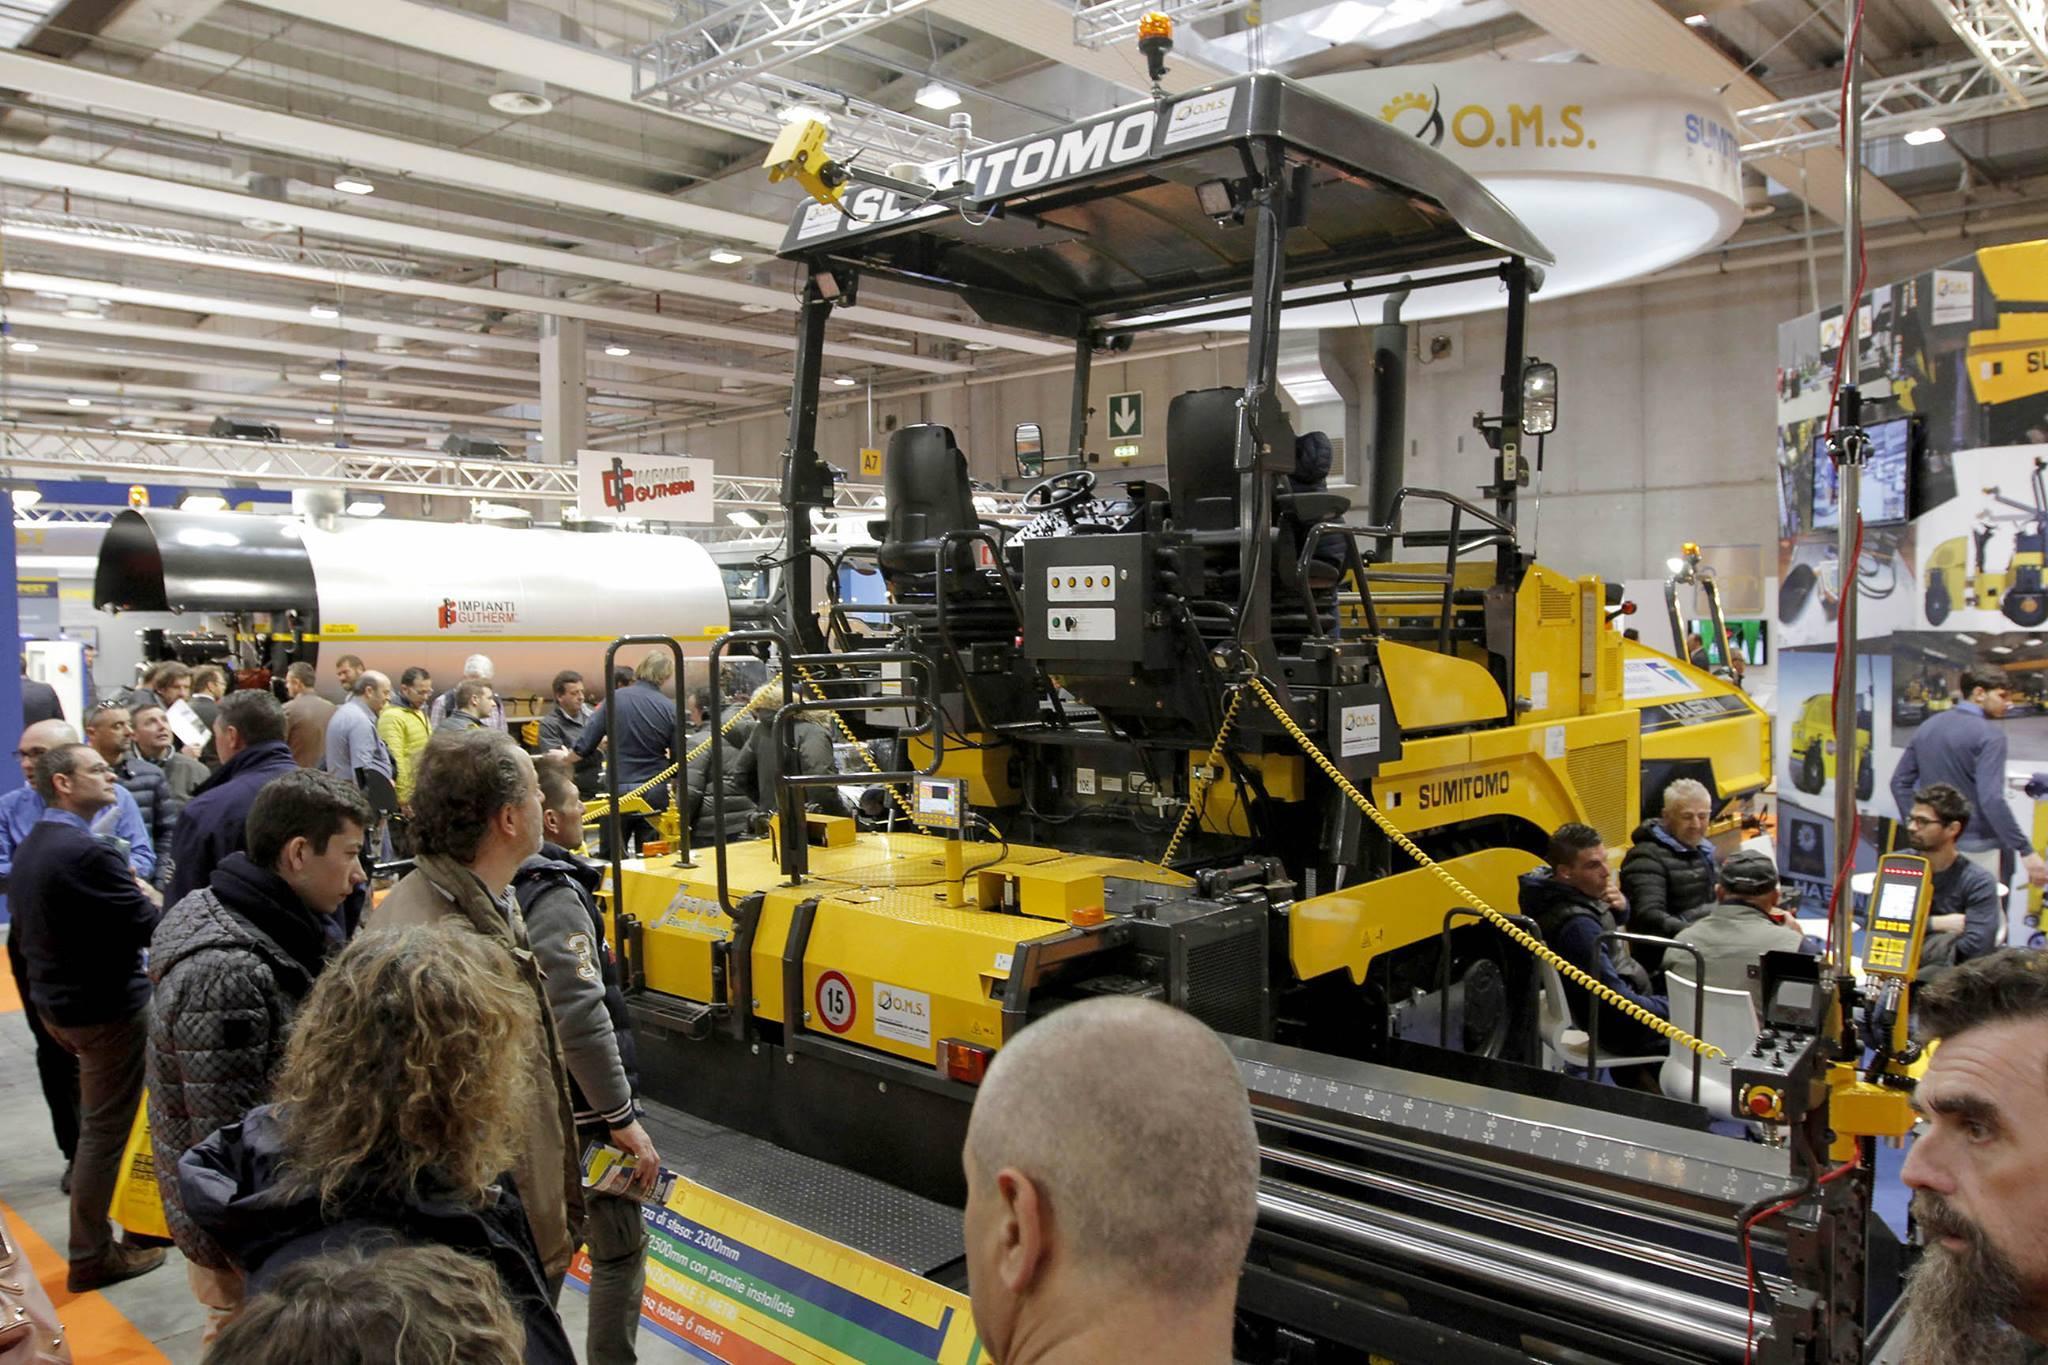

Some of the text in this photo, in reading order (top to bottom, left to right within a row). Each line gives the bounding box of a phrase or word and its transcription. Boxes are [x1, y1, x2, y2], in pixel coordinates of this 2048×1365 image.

[1452, 103, 1597, 149] O.M.S.
[864, 455, 878, 470] A7
[635, 480, 695, 502] GUTHERM
[458, 601, 515, 612] IMPIANTI
[458, 612, 514, 623] GUTHERM
[1419, 771, 1509, 810] SUMITOMO
[567, 932, 596, 979] 3
[828, 987, 844, 1014] 15
[893, 998, 926, 1017] O.M.S.
[641, 1206, 741, 1262] zza di stesa: 2300mm
[648, 1234, 796, 1319] 2500mm con paratie installate
[900, 1288, 912, 1305] 2
[656, 1302, 685, 1325] totale
[685, 1316, 694, 1332] 6
[694, 1323, 725, 1346] metri
